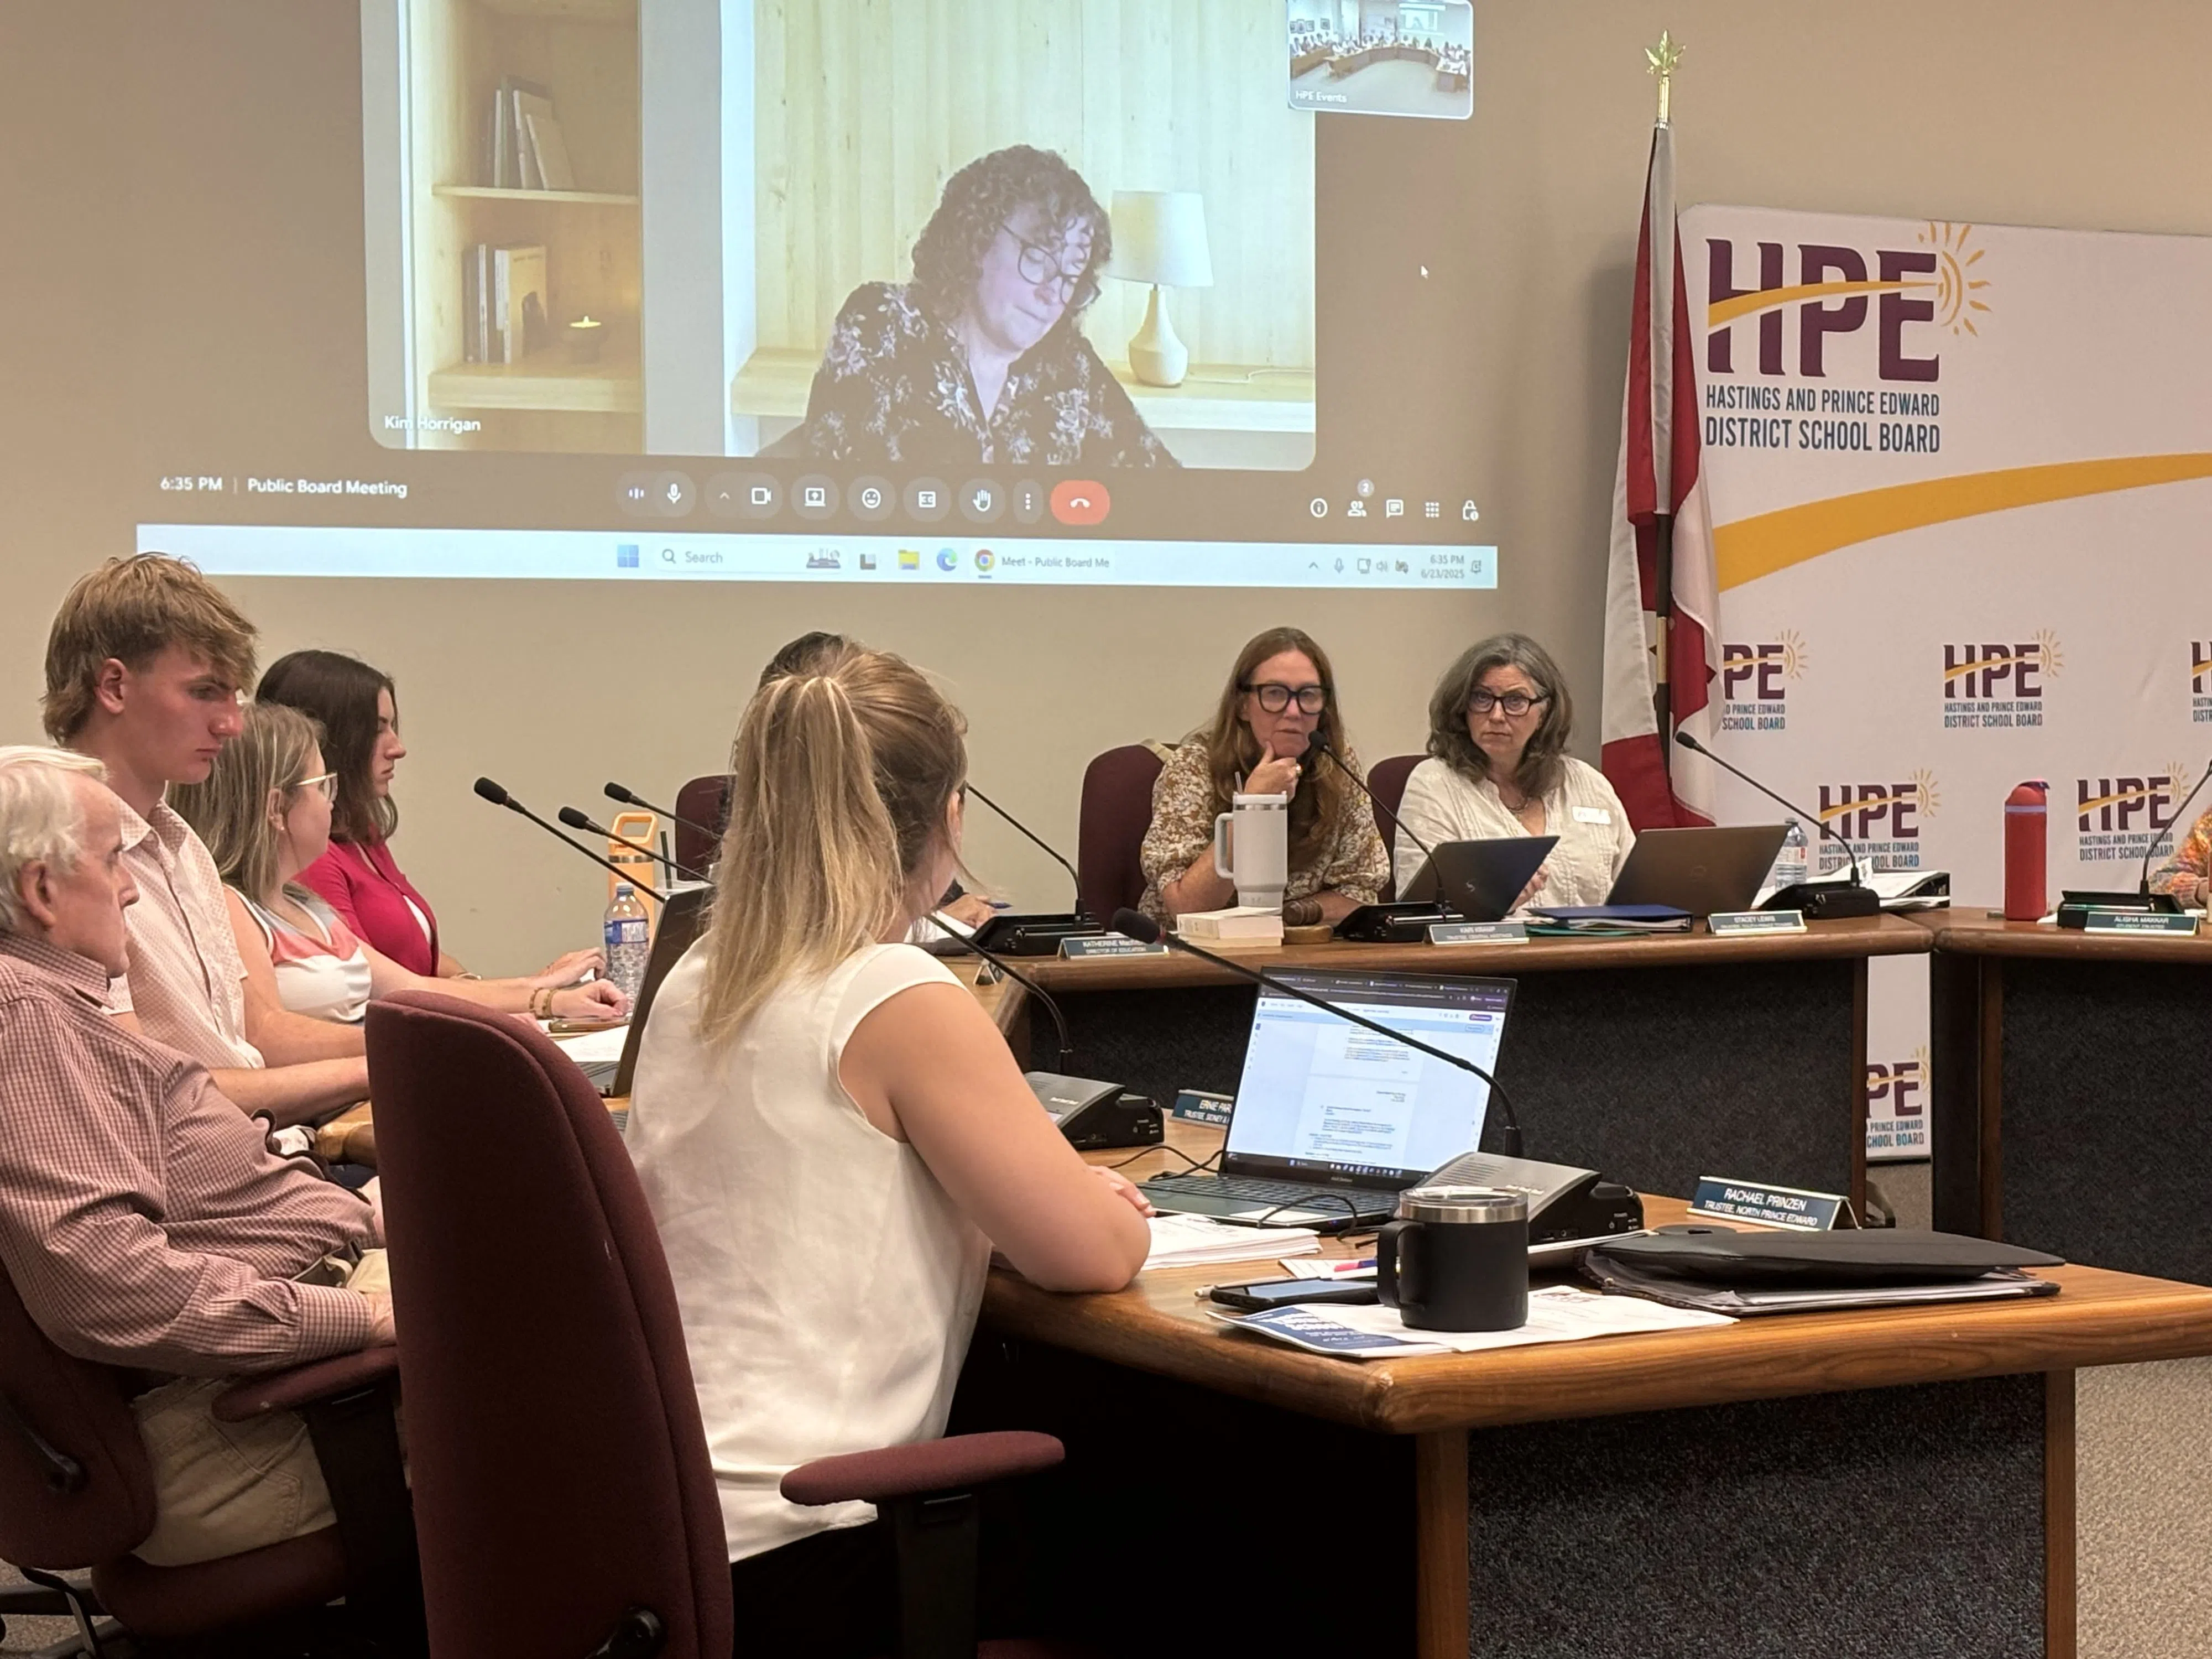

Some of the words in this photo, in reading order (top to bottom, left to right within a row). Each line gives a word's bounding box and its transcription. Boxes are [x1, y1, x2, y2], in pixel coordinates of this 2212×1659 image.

[1296, 90, 1314, 100] HPE
[1316, 91, 1347, 103] Events
[1706, 238, 1939, 383] HPE
[1706, 384, 1781, 411] HASTINGS
[1786, 388, 1816, 413] AND
[1822, 389, 1875, 414] PRINCE
[1880, 392, 1940, 417] EDWARD
[384, 416, 413, 429] Kim
[417, 416, 481, 434] Horrigan
[1705, 416, 1792, 448] DISTRICT
[1798, 419, 1872, 451] SCHOOL
[1879, 422, 1940, 453] BOARD
[160, 477, 193, 492] 6:35
[198, 477, 222, 491] PM
[248, 478, 294, 493] Public
[298, 479, 342, 494] Board
[346, 481, 408, 499] Meeting
[685, 551, 723, 564] Search
[1001, 556, 1026, 566] Meet
[1035, 557, 1063, 567] Public
[1065, 557, 1093, 568] Board
[1094, 558, 1109, 568] Me
[1451, 555, 1465, 565] PM
[1421, 568, 1465, 579] 6/23/2025
[1722, 644, 1785, 700] PE
[1943, 644, 2042, 698] HPE
[1732, 704, 1756, 714] PRINCE
[1758, 703, 1785, 714] EDWARD
[1944, 702, 1975, 712] HASTINGS
[1977, 702, 1990, 712] AND
[1991, 701, 2014, 712] PRINCE
[2016, 701, 2042, 711] EDWARD
[1722, 717, 1755, 730] SCHOOL
[1757, 717, 1786, 730] BOARD
[1944, 715, 1980, 728] DISTRICT
[1983, 714, 2013, 727] SCHOOL
[2016, 714, 2043, 727] BOARD
[2077, 776, 2172, 832] HPE
[1819, 784, 1918, 839] HPE
[2079, 835, 2111, 846] HASTINGS
[2112, 834, 2126, 845] AND
[2128, 833, 2149, 844] PRINCE
[1853, 843, 1866, 854] AND
[1867, 842, 1891, 853] PRINCE
[1892, 842, 1919, 852] EDWARD
[2080, 847, 2116, 861] DISTRICT
[1892, 854, 1919, 868] BOARD
[1866, 1062, 1922, 1118] PE
[1870, 1120, 1895, 1133] PRINCE
[1896, 1119, 1923, 1131] EDWARD
[1867, 1134, 1893, 1148] CHOOL
[1896, 1132, 1924, 1146] BOARD
[1723, 1188, 1765, 1206] RACHAEL
[1766, 1194, 1808, 1212] PRINZEN
[1736, 1204, 1761, 1217] NORTH
[1760, 1209, 1788, 1222] PRINCE
[1786, 1213, 1818, 1227] EDWARD
